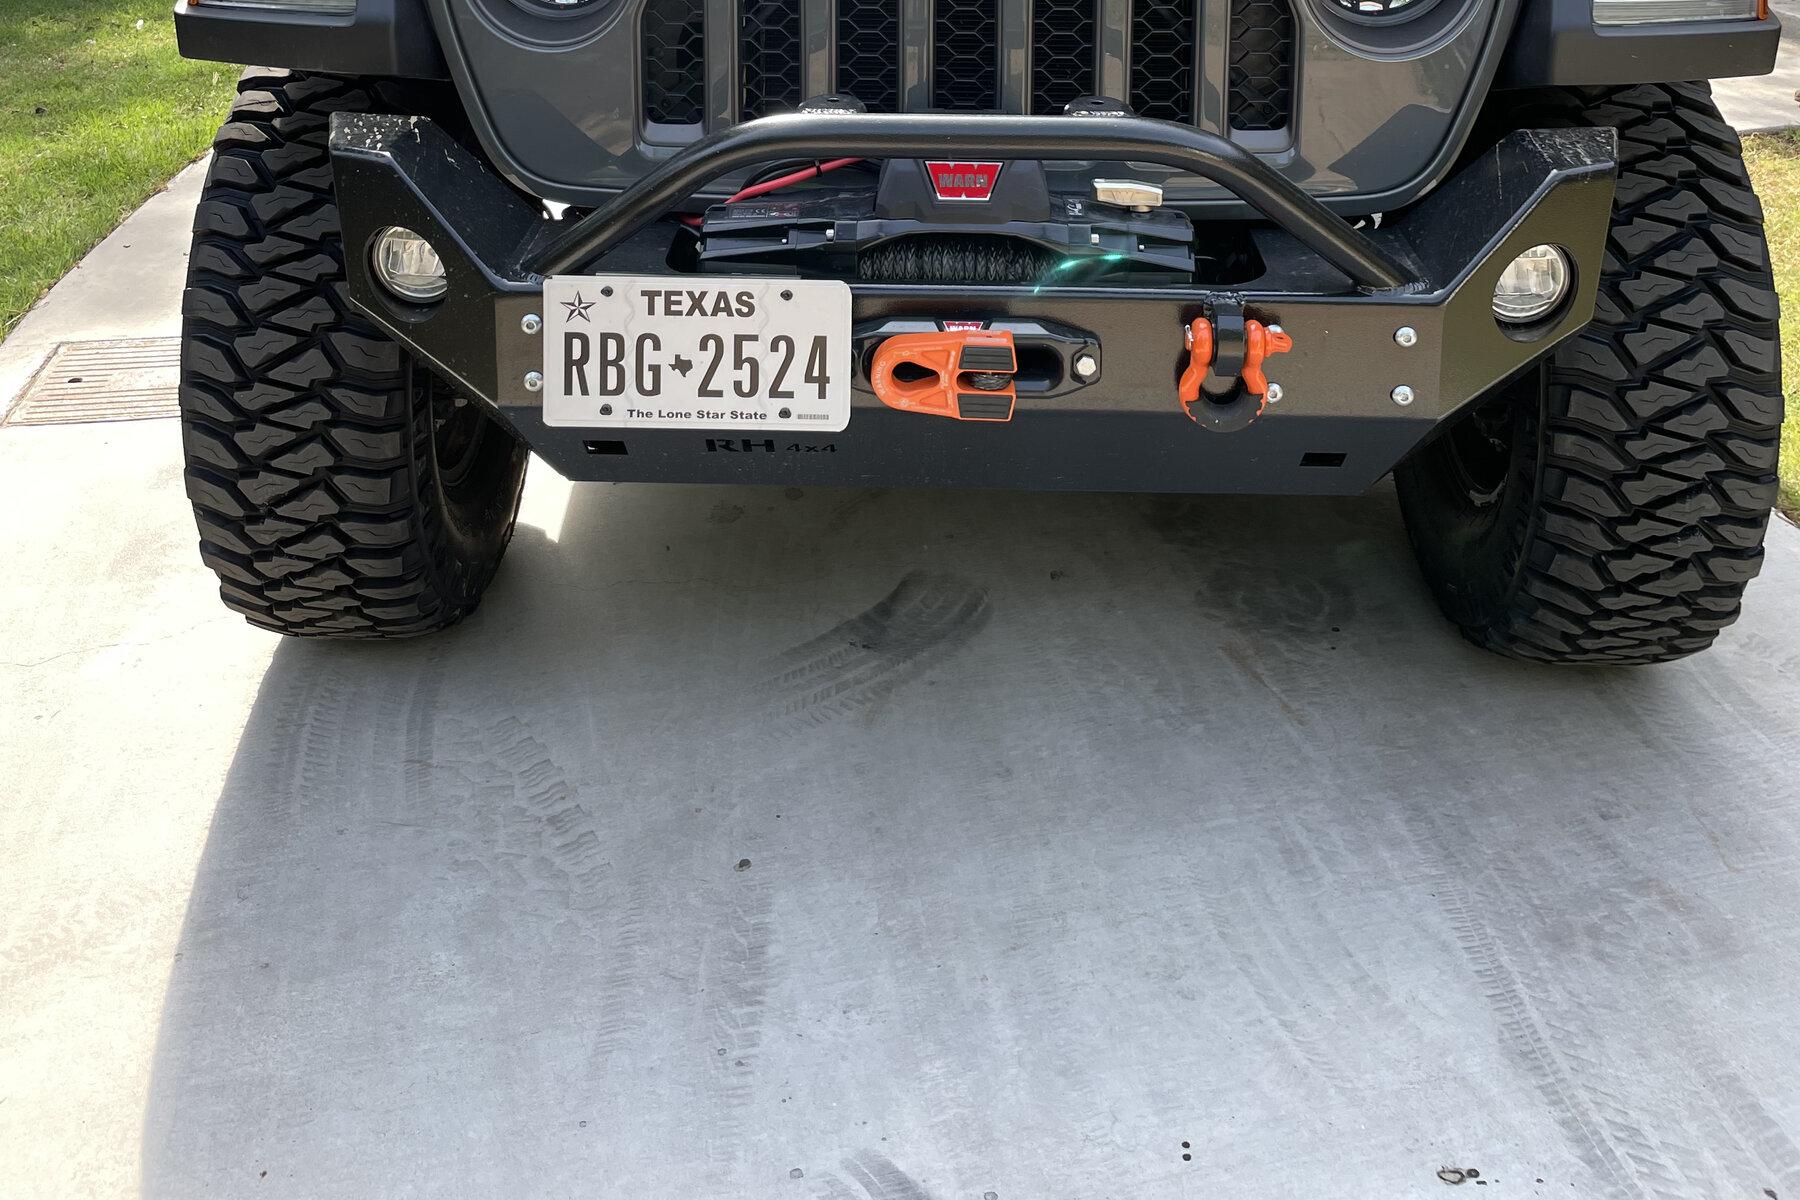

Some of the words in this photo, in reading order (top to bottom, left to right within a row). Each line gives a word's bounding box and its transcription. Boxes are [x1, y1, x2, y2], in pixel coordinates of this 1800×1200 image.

[938, 174, 988, 188] WARN
[640, 290, 756, 318] TEXAS
[563, 331, 662, 397] RBG
[697, 333, 831, 400] 2524
[627, 409, 654, 419] The
[658, 409, 692, 419] Lone
[696, 409, 727, 420] Star
[731, 409, 767, 420] State
[705, 438, 776, 453] RH
[787, 443, 838, 453] 4x4
